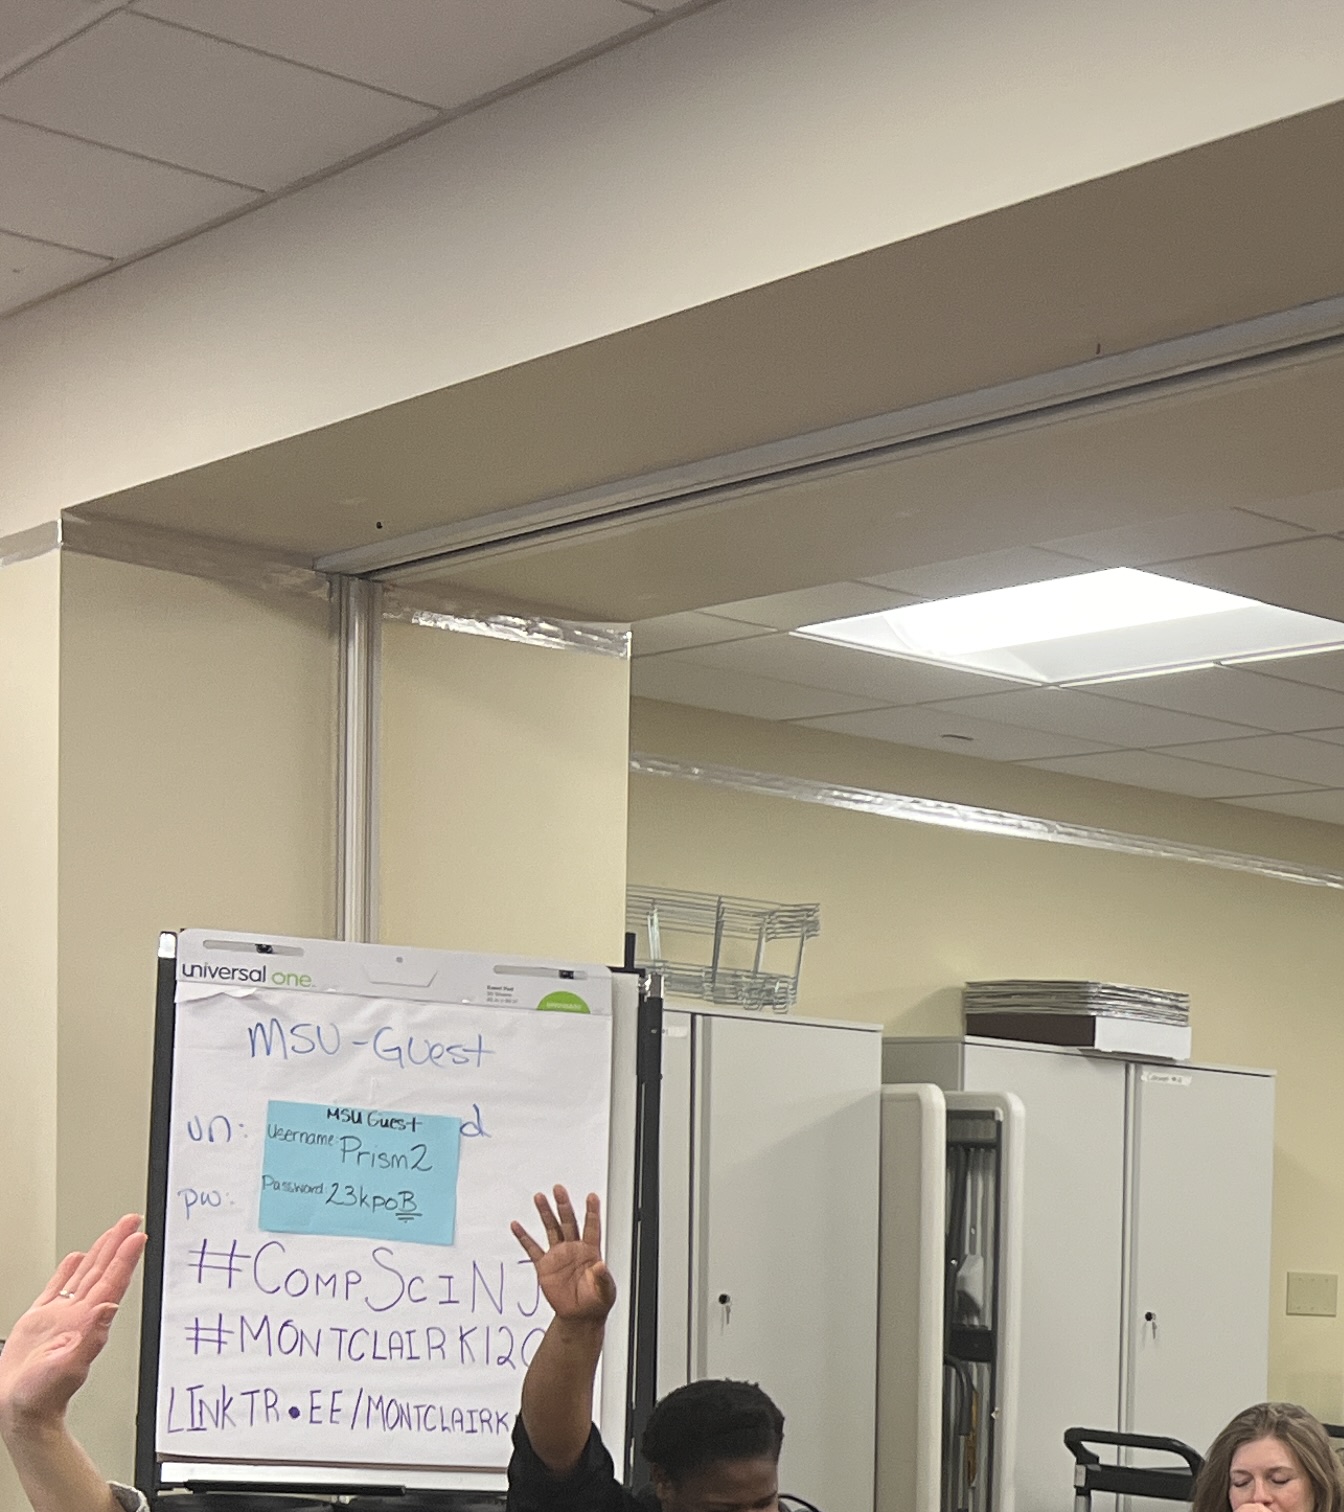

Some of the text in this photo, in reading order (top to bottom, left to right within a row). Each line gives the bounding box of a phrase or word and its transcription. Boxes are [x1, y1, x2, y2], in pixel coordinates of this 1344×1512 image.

[181, 961, 313, 988] universal one
[326, 1107, 423, 1133] MSU Guest
[340, 1135, 433, 1172] Prism2
